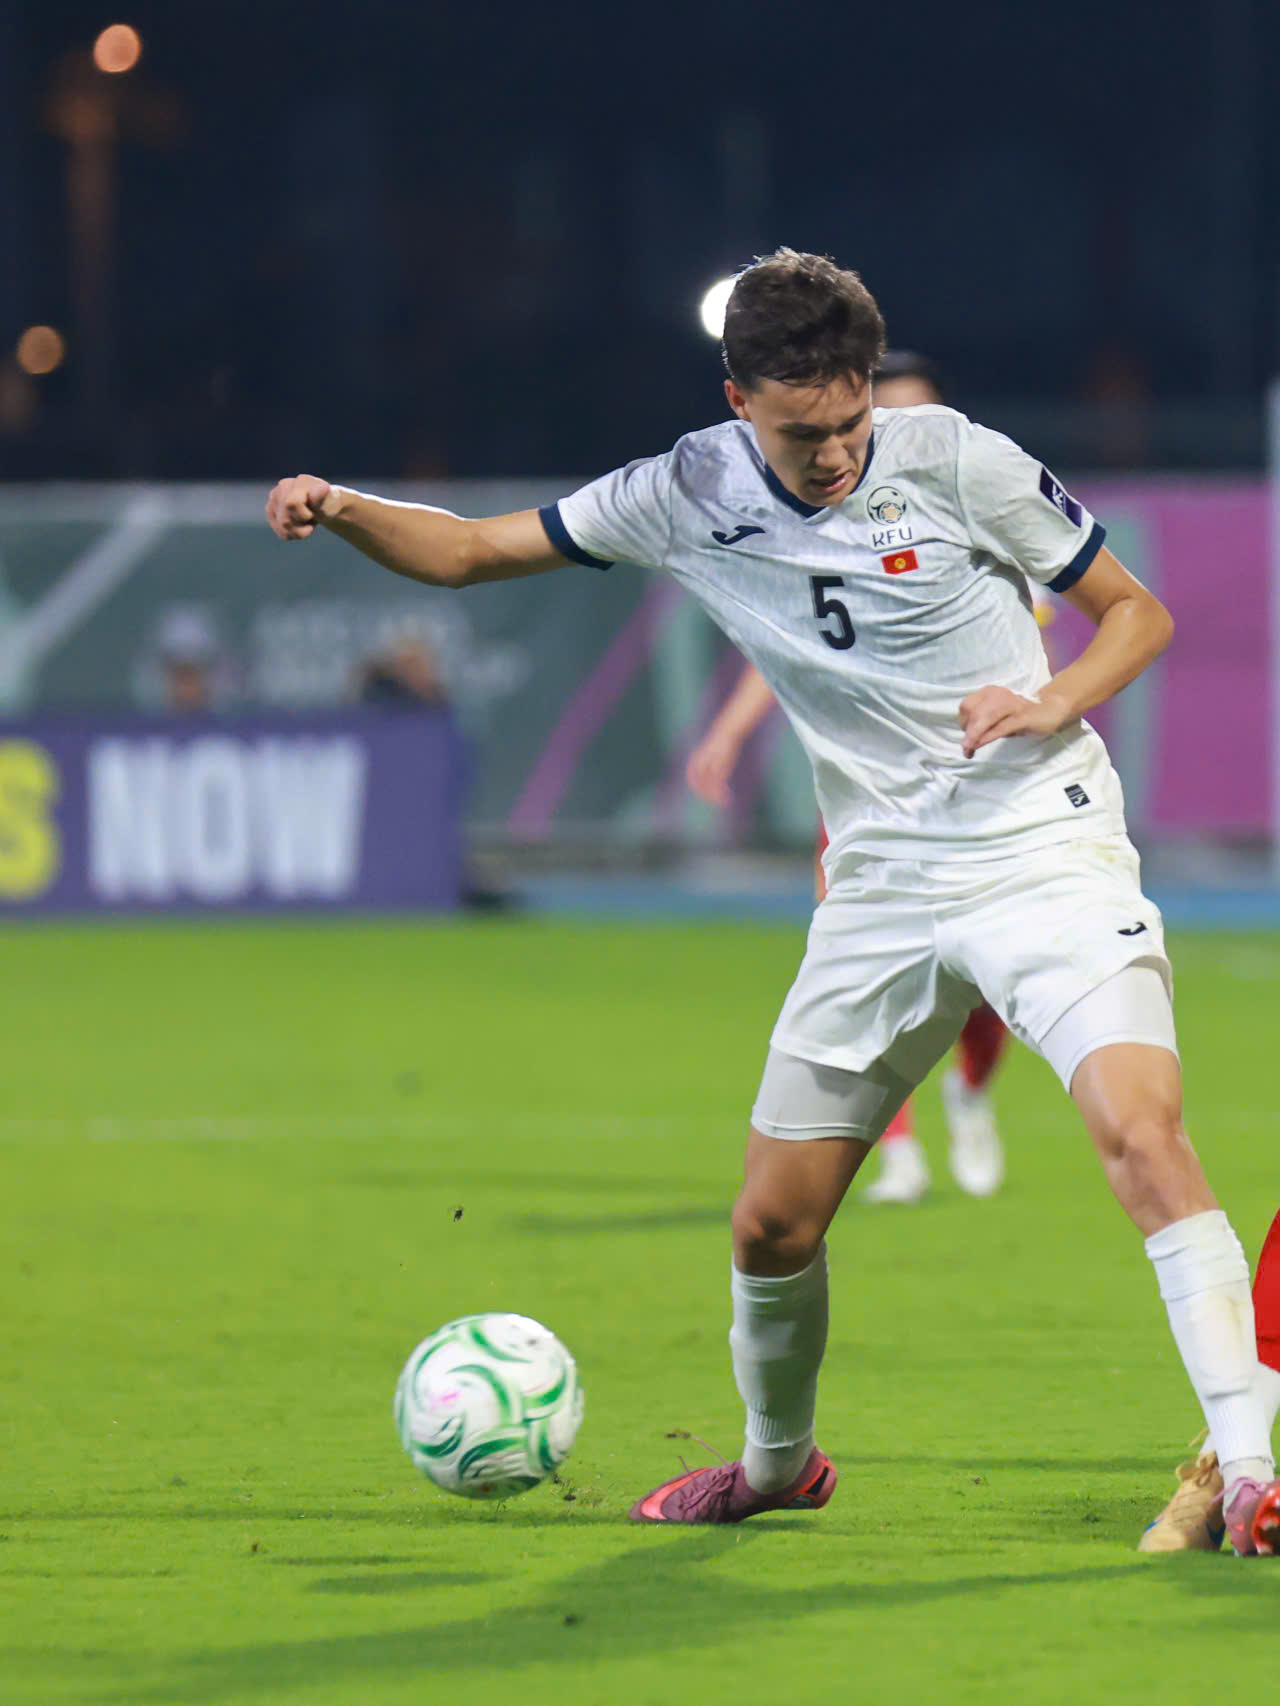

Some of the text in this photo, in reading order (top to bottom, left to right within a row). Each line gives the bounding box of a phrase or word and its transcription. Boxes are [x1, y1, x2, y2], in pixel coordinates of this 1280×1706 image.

[872, 526, 912, 547] KFU
[809, 575, 856, 650] 5
[91, 736, 366, 897] NOW
